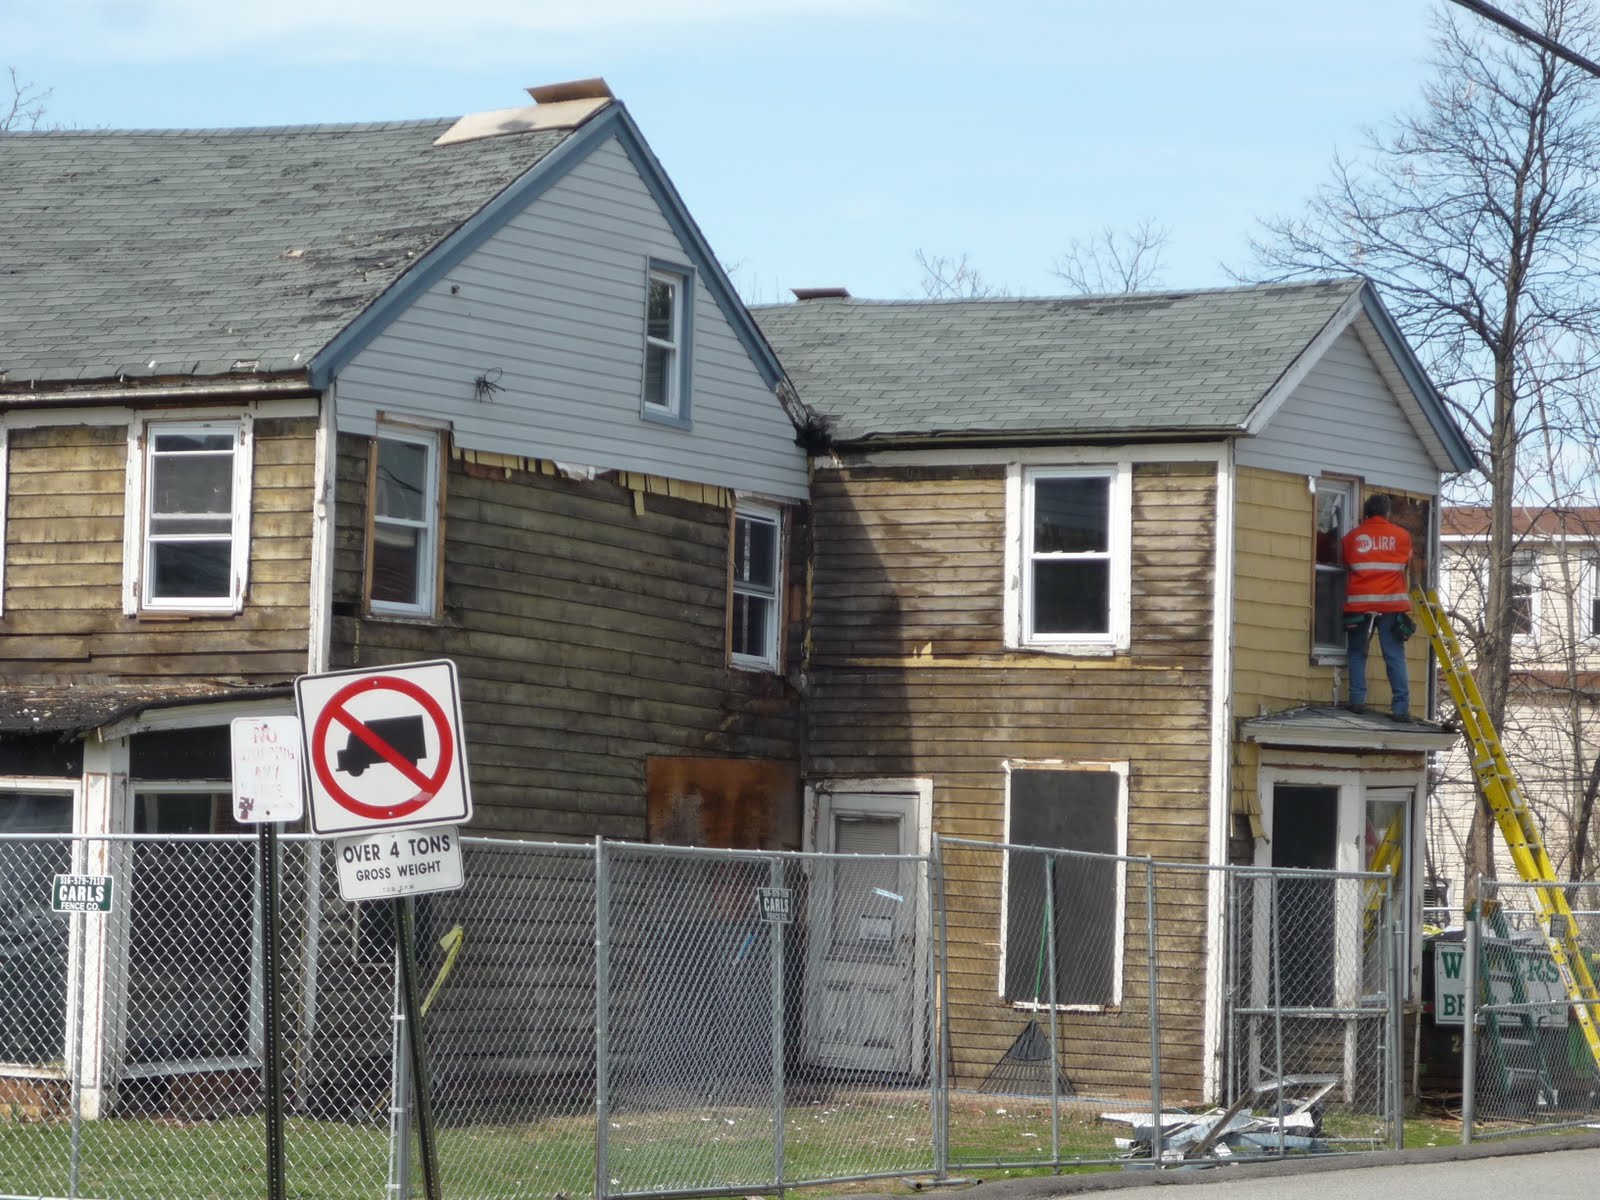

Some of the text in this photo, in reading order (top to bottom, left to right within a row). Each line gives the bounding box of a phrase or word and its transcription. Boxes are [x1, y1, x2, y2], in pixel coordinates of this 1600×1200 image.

[1372, 536, 1396, 551] LIRR
[343, 834, 450, 863] OVER 4 TONS
[356, 861, 440, 881] GROSS WEIGHT
[59, 885, 105, 902] CARLS
[61, 901, 85, 910] FENCE
[764, 897, 788, 912] CARLS
